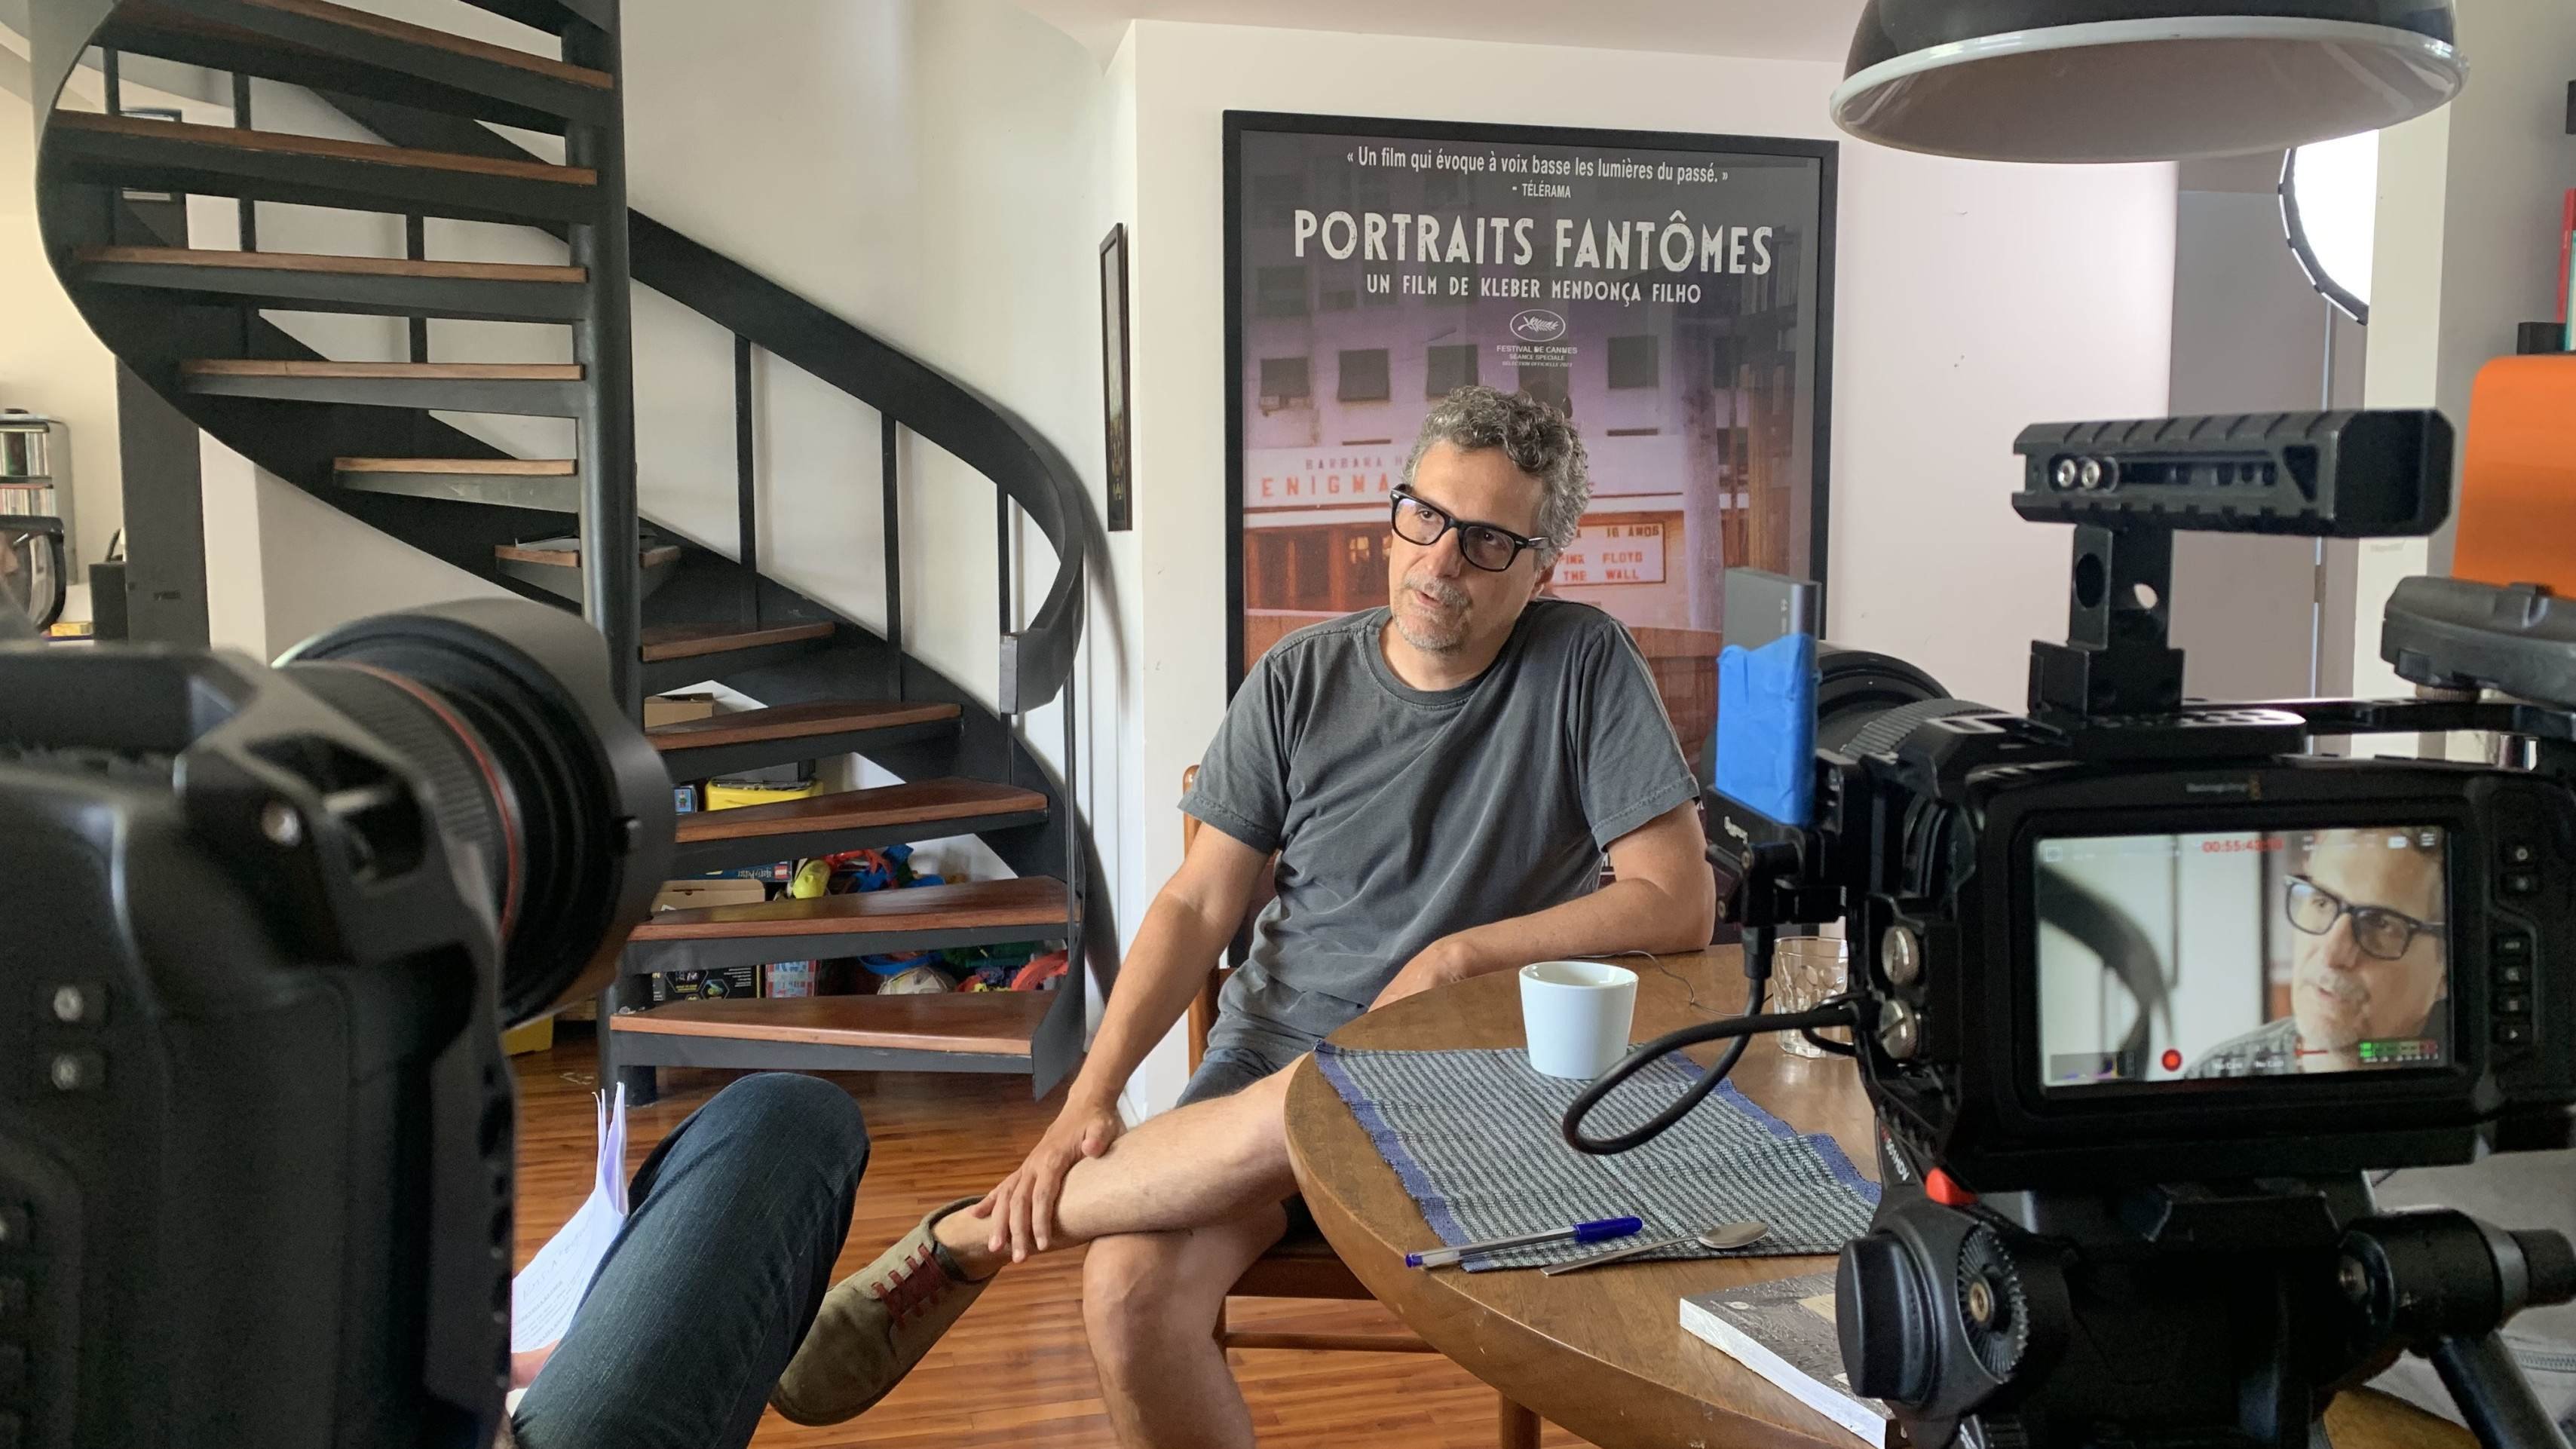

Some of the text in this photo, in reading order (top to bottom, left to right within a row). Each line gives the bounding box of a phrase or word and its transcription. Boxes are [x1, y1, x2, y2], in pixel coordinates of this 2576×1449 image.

[1358, 146, 1377, 167] Un
[1381, 148, 1406, 167] film
[1411, 149, 1432, 173] qui
[1436, 148, 1485, 175] évoque
[1489, 151, 1496, 172] à
[1501, 154, 1528, 173] voix
[1532, 155, 1570, 175] basse
[1576, 157, 1594, 176] les
[1597, 158, 1653, 180] lumières
[1658, 161, 1673, 181] du
[1677, 163, 1718, 185] passé.
[1521, 179, 1571, 198] TÉLÉRAMA
[1294, 210, 1772, 274] PORTRAITS FANTÔMES
[1367, 274, 1702, 307] UN FILM DE KLEBER MENDONÇA FILHO
[1496, 345, 1578, 354] FESTIVAL DE CANNES
[1306, 457, 1382, 470] BARBARA
[1261, 473, 1389, 498] ENIGMA
[1602, 551, 1643, 564] FLOYD
[1563, 568, 1640, 581] THE WALL
